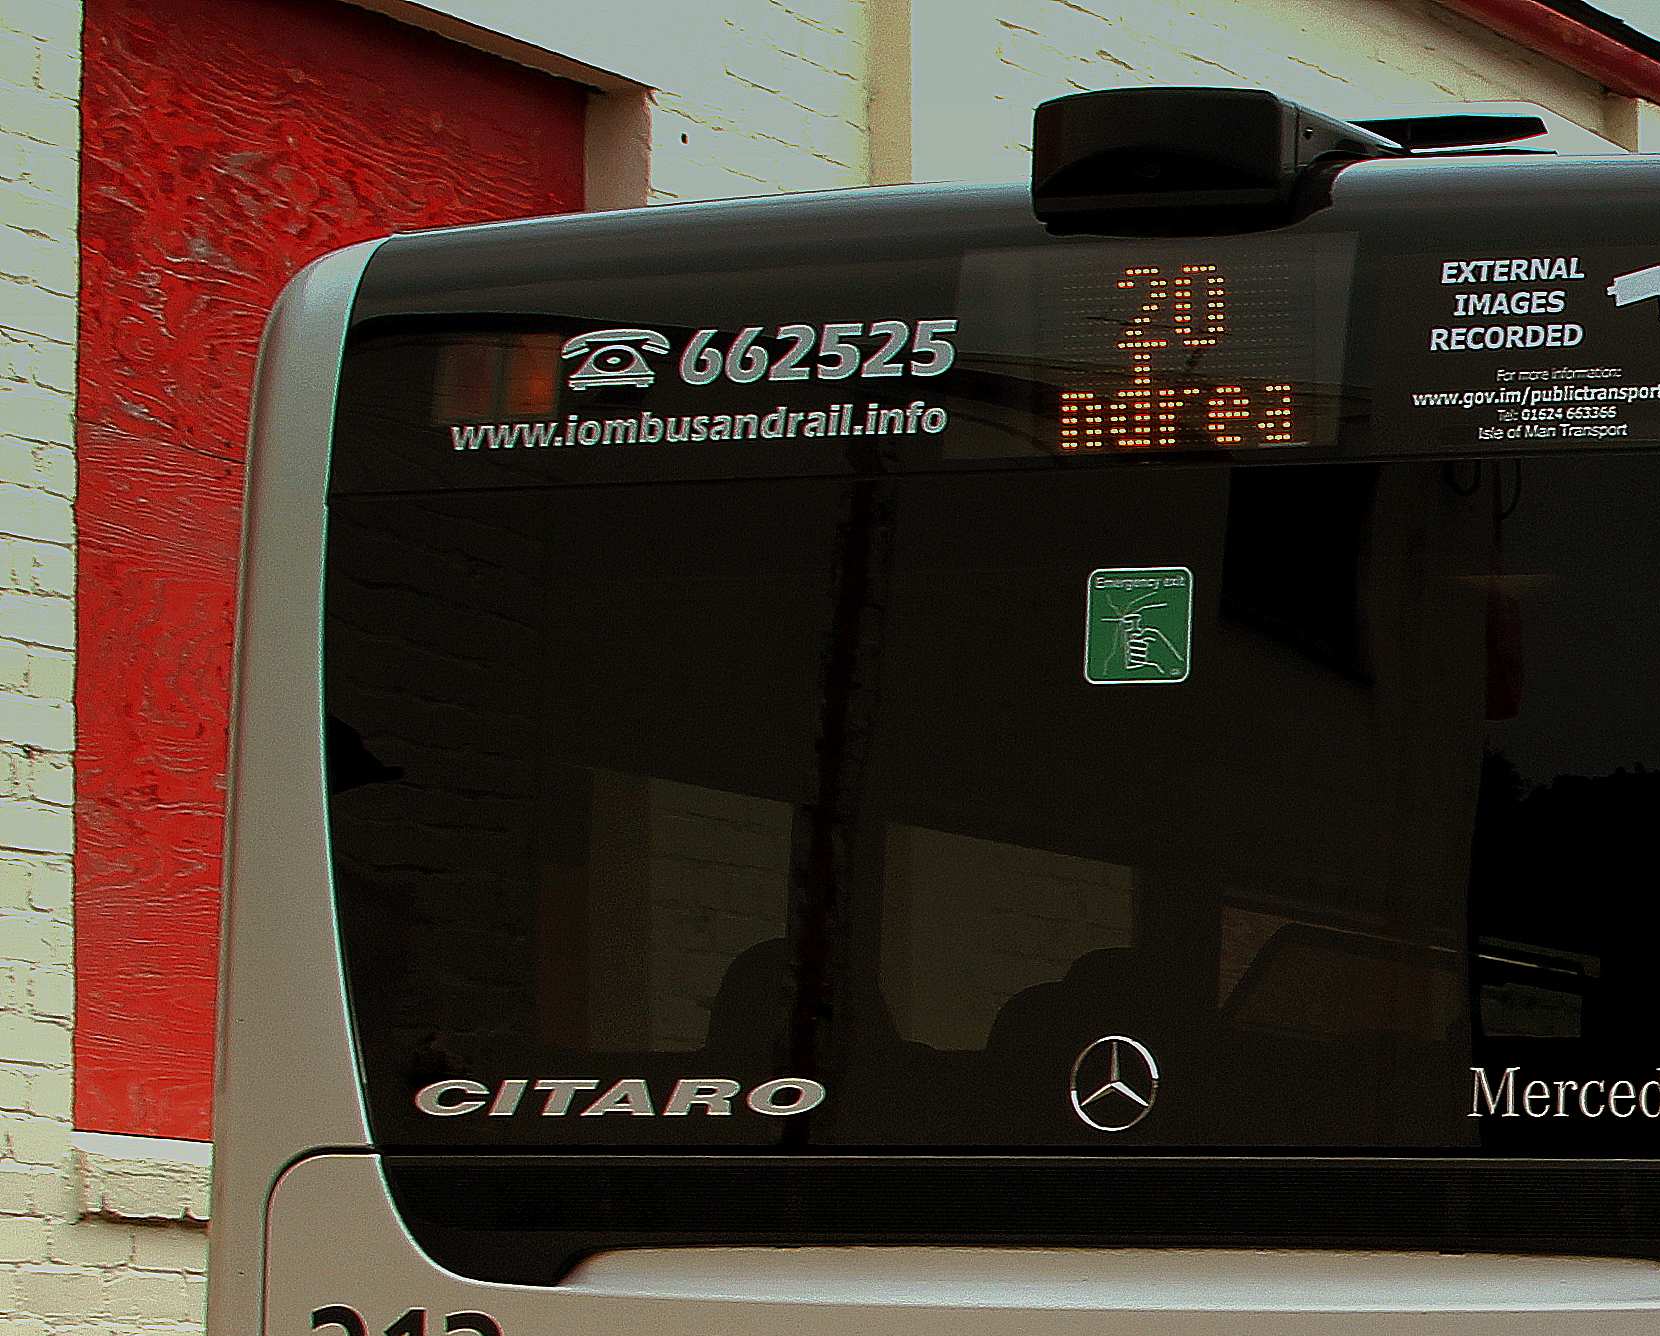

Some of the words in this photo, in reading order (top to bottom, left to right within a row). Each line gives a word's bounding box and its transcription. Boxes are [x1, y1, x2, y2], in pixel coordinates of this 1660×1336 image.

[1441, 258, 1585, 284] EXTERNAL
[1117, 264, 1225, 348] 20
[1453, 291, 1566, 316] IMAGES
[1430, 324, 1583, 351] RECORDED
[679, 319, 959, 386] 662525
[1497, 368, 1516, 381] For
[1518, 370, 1549, 381] more
[450, 400, 948, 451] www.iombusandrail.info
[1478, 426, 1504, 441] Isle
[1506, 425, 1521, 439] of
[1524, 424, 1556, 439] Man
[1560, 423, 1628, 440] Transport
[415, 1078, 826, 1117] CITARO
